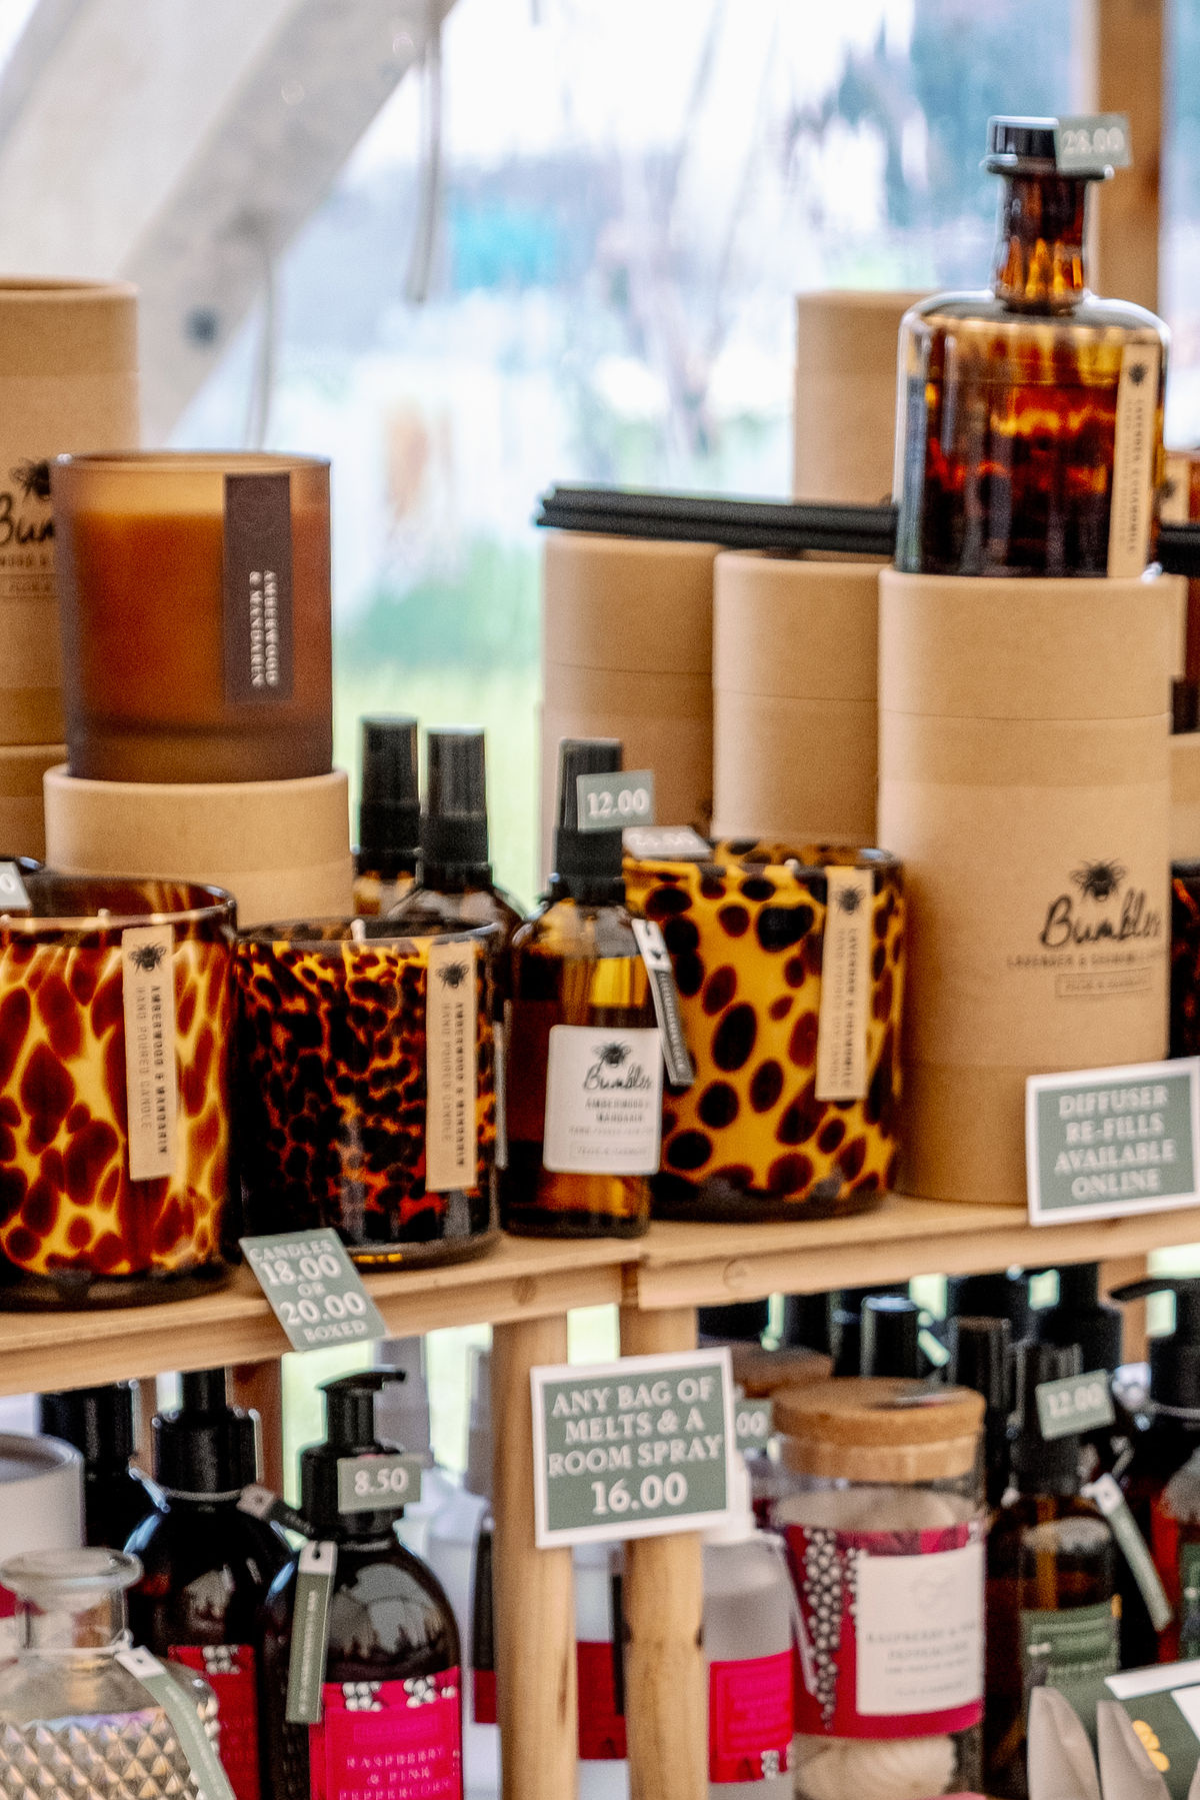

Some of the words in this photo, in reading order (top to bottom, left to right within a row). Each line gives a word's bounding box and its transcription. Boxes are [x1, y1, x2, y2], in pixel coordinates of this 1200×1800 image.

[587, 788, 650, 818] 12.00
[1058, 1085, 1169, 1120] DIFFUSER
[1065, 1112, 1165, 1146] RE-FILLS
[1053, 1139, 1177, 1176] AVAILABLE
[1071, 1168, 1162, 1200] ONLINE
[249, 1239, 334, 1262] CANDLES
[260, 1253, 342, 1287] 18.00
[297, 1281, 326, 1298] OR
[279, 1291, 368, 1327] 20.00
[303, 1319, 368, 1343] BOXED
[552, 1387, 611, 1418] ANY
[618, 1380, 672, 1410] BAG
[677, 1375, 717, 1402] OF
[1049, 1384, 1101, 1417] 12.00
[564, 1411, 652, 1445] MELTS
[656, 1408, 680, 1435] &
[684, 1406, 706, 1432] A
[548, 1444, 633, 1478] ROOM
[637, 1433, 724, 1467] SPRAY
[354, 1467, 409, 1497] 8.50
[591, 1471, 689, 1516] 16.00
[346, 1747, 445, 1771] RASPBERRY
